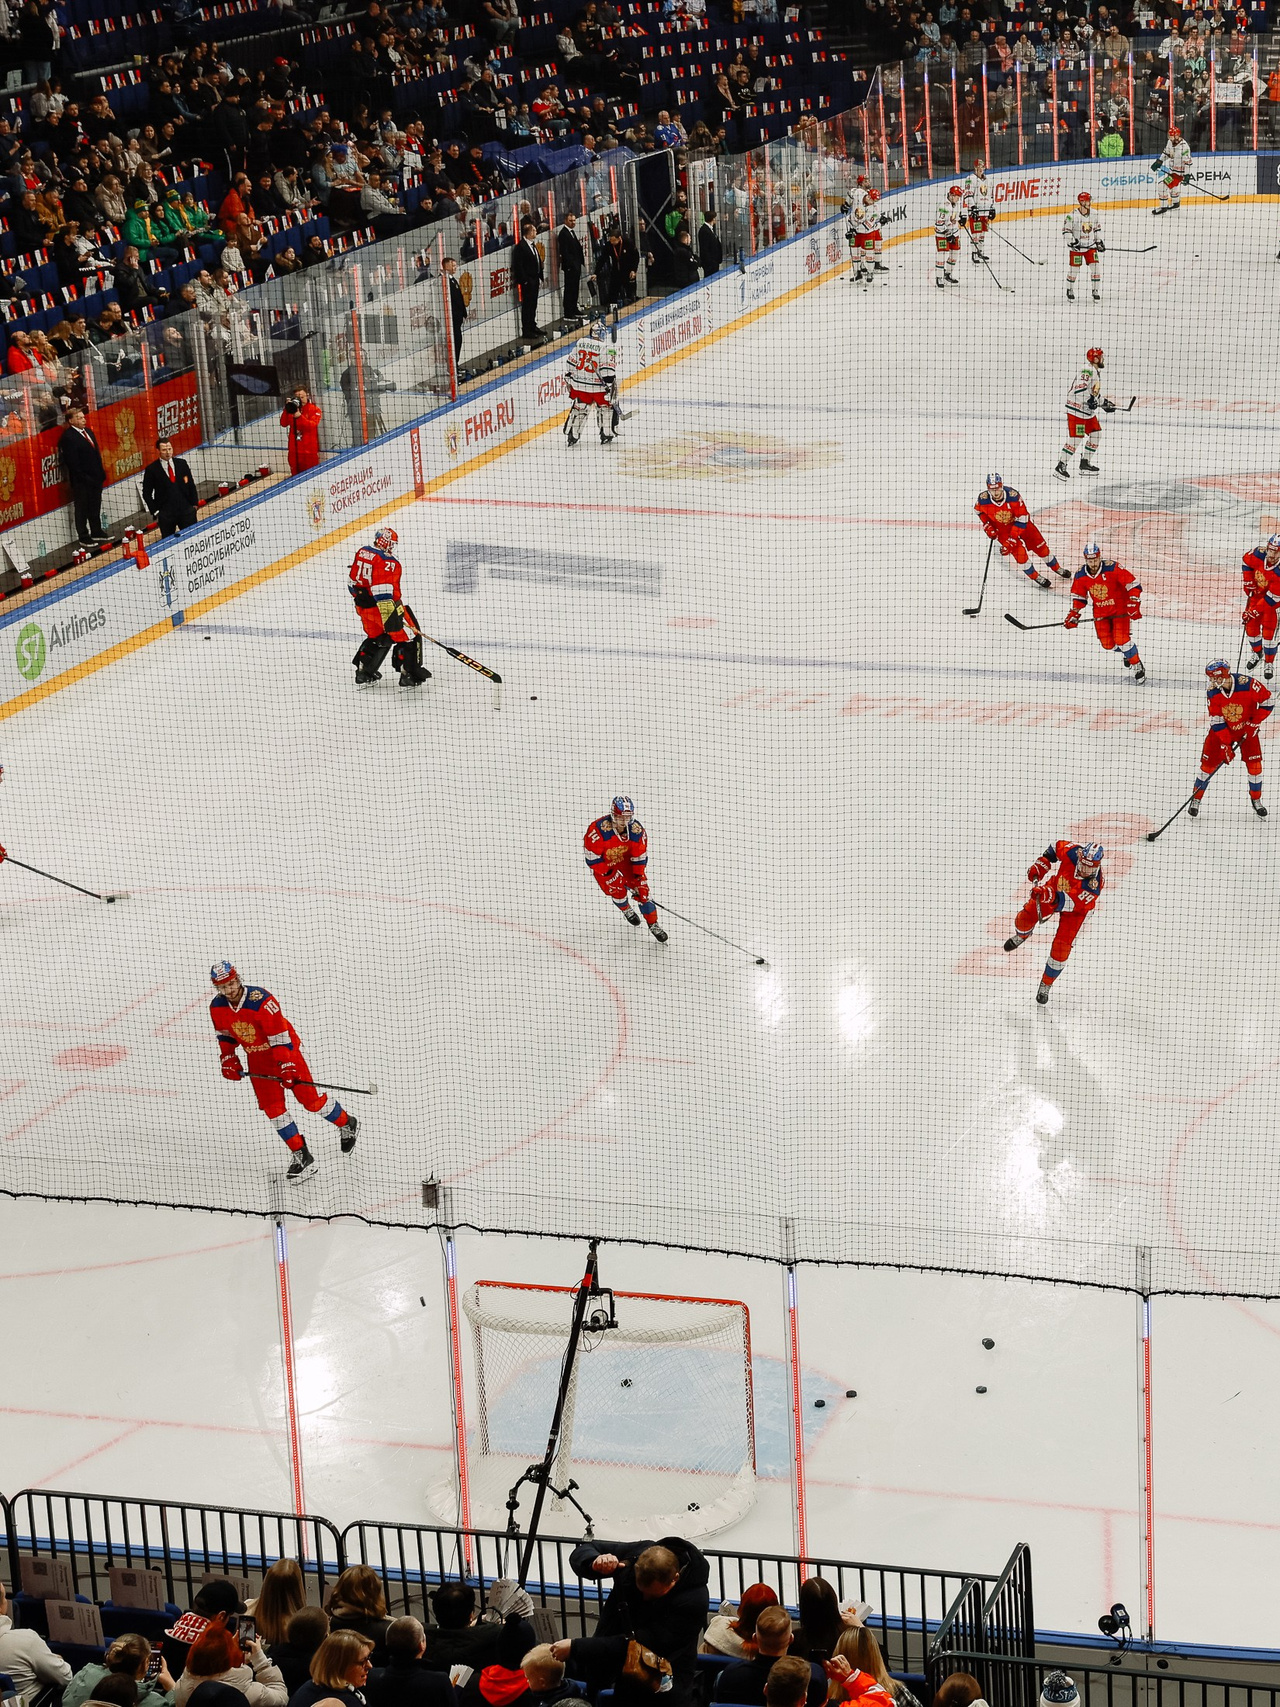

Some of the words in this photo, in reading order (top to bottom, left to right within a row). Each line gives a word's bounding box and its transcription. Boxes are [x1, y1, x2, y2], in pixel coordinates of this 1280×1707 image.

[994, 178, 1041, 203] CHINE
[1101, 174, 1155, 187] СИБИРЬ
[575, 349, 601, 374] 35
[157, 398, 180, 428] RED
[464, 397, 516, 447] FHR.RU
[329, 466, 374, 497] ФЕДЕРАЦИЯ
[331, 490, 362, 515] ХОККЕЯ
[360, 474, 393, 501] РОССИИ
[0, 502, 25, 525] ОССИЯ
[184, 518, 252, 560] ПРАВИТЕЛЬСТВО
[186, 531, 256, 577] НОВОСИБИРСКОЙ
[188, 565, 226, 594] ОБЛАСТИ
[49, 606, 107, 653] Airlines
[1077, 889, 1095, 905] 89
[1058, 1687, 1077, 1699] STA
